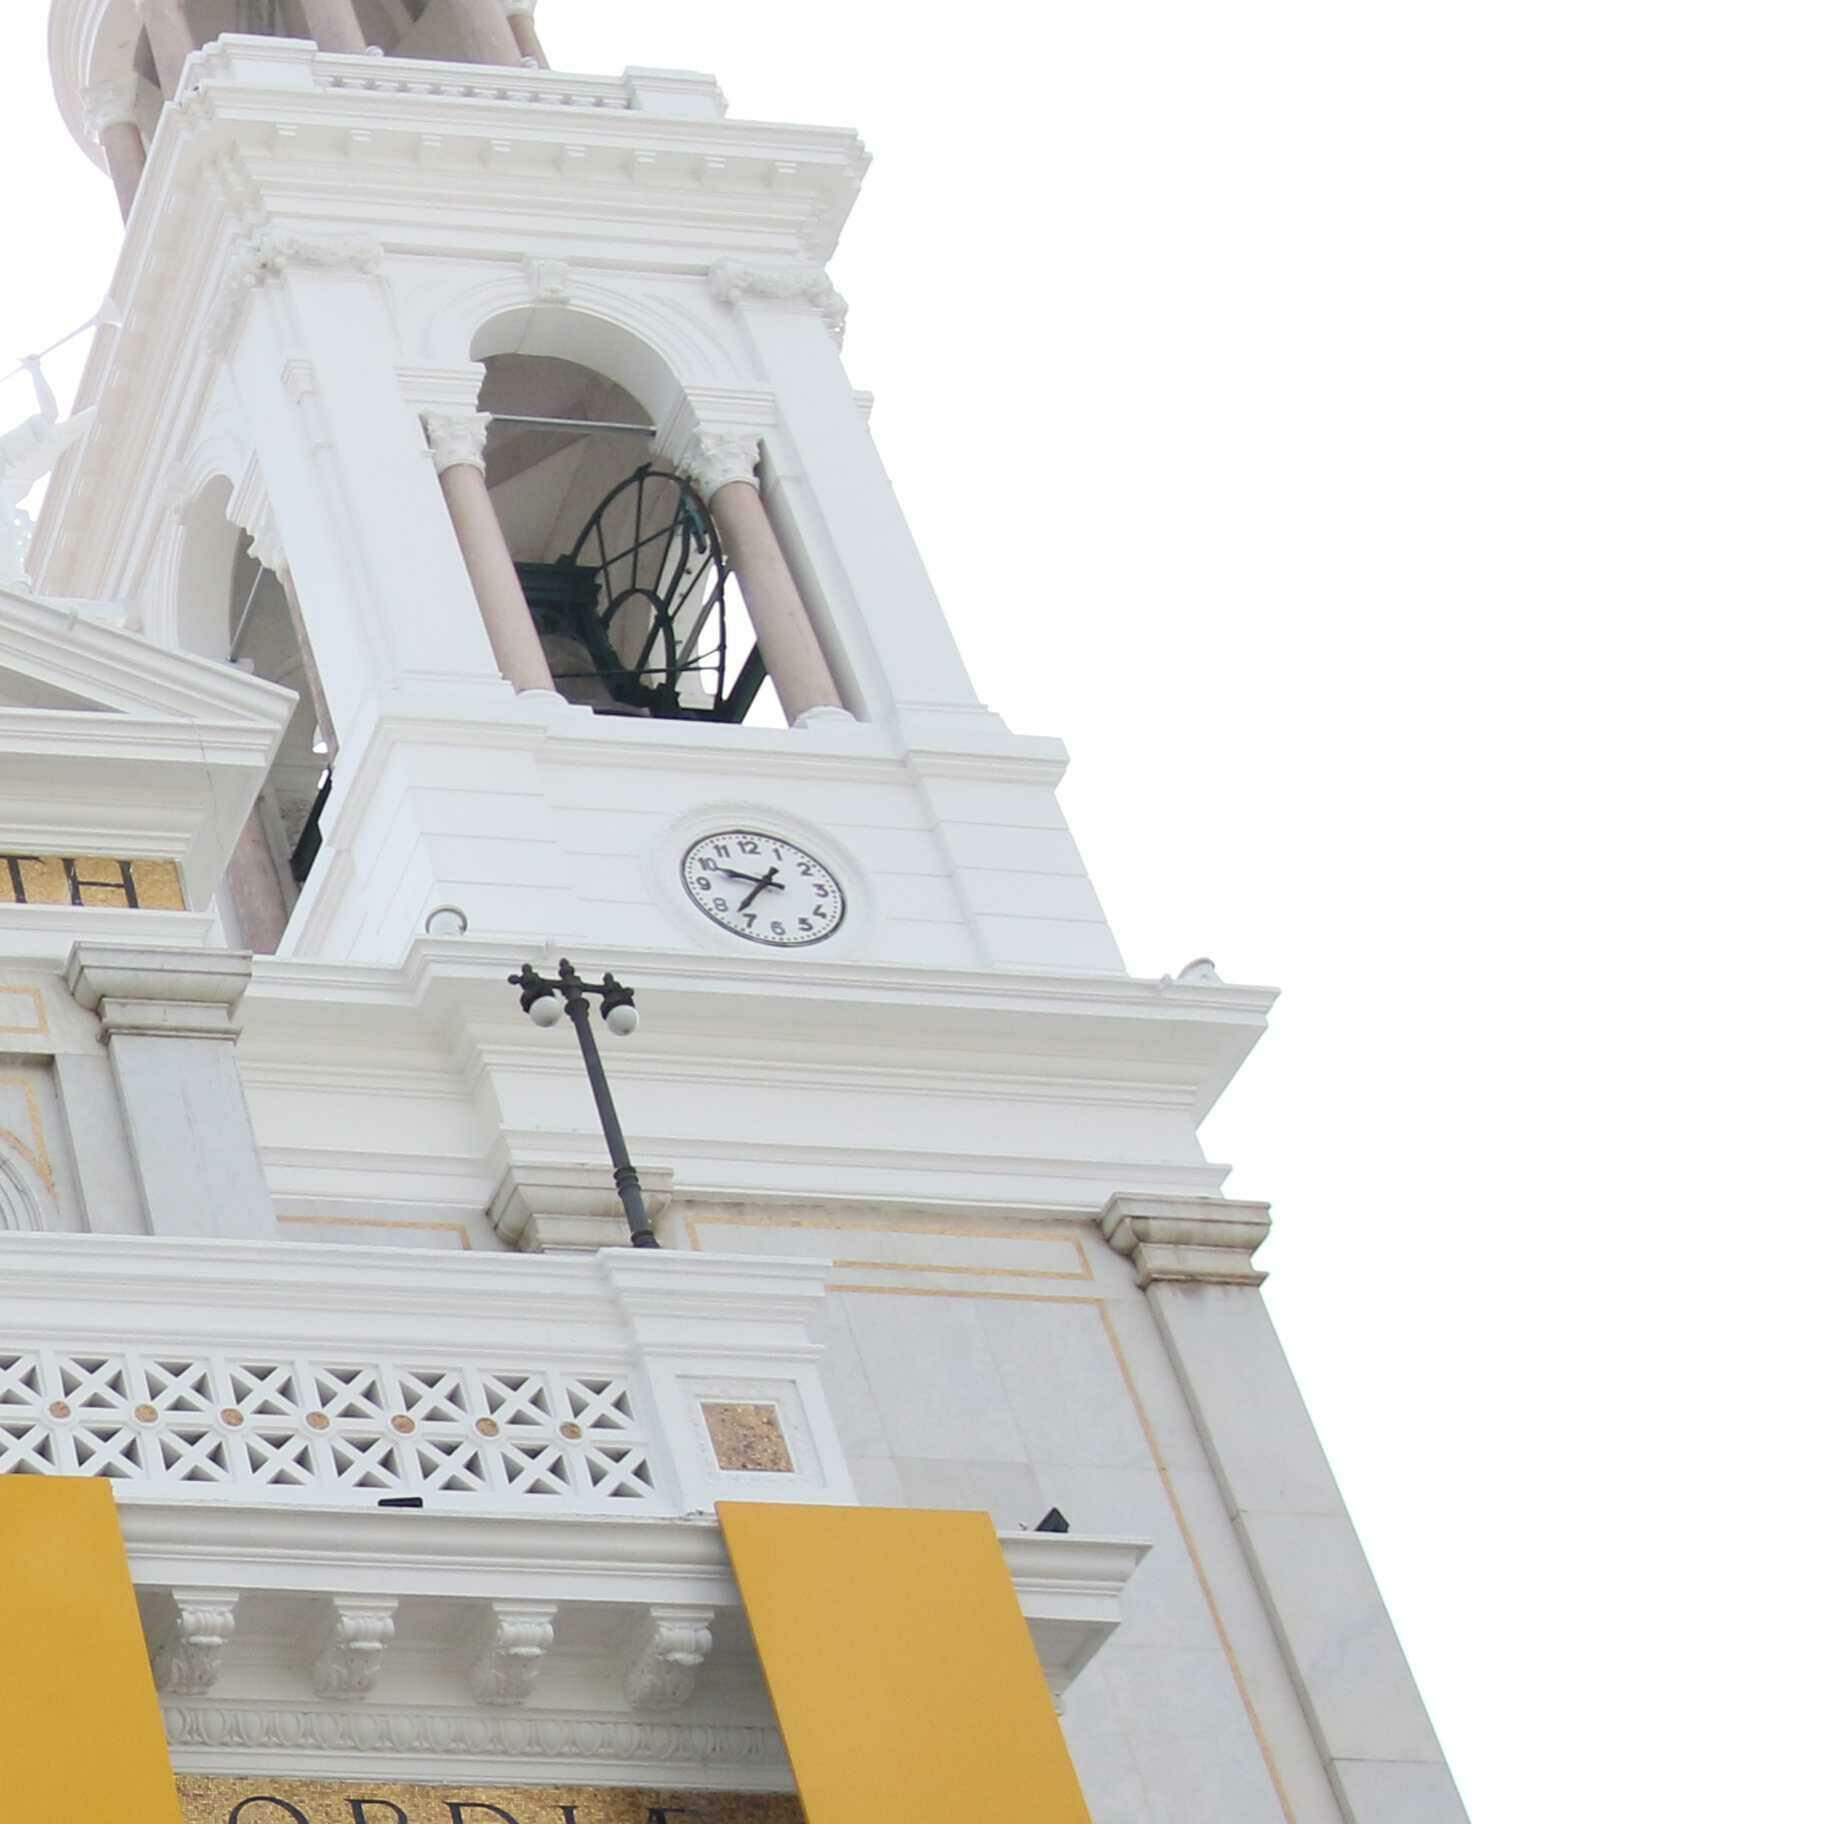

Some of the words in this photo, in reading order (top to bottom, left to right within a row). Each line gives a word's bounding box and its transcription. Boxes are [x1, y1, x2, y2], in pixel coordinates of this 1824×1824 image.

[713, 844, 731, 859] 11
[737, 841, 761, 855] 12
[772, 847, 783, 861] 1
[697, 857, 717, 872] 10
[797, 862, 814, 877] 2
[696, 876, 712, 891] 9
[812, 883, 829, 898] 3
[712, 897, 729, 912] 8
[813, 904, 827, 920] 4
[742, 913, 758, 929] 7
[770, 921, 786, 936] 6
[798, 917, 814, 932] 5
